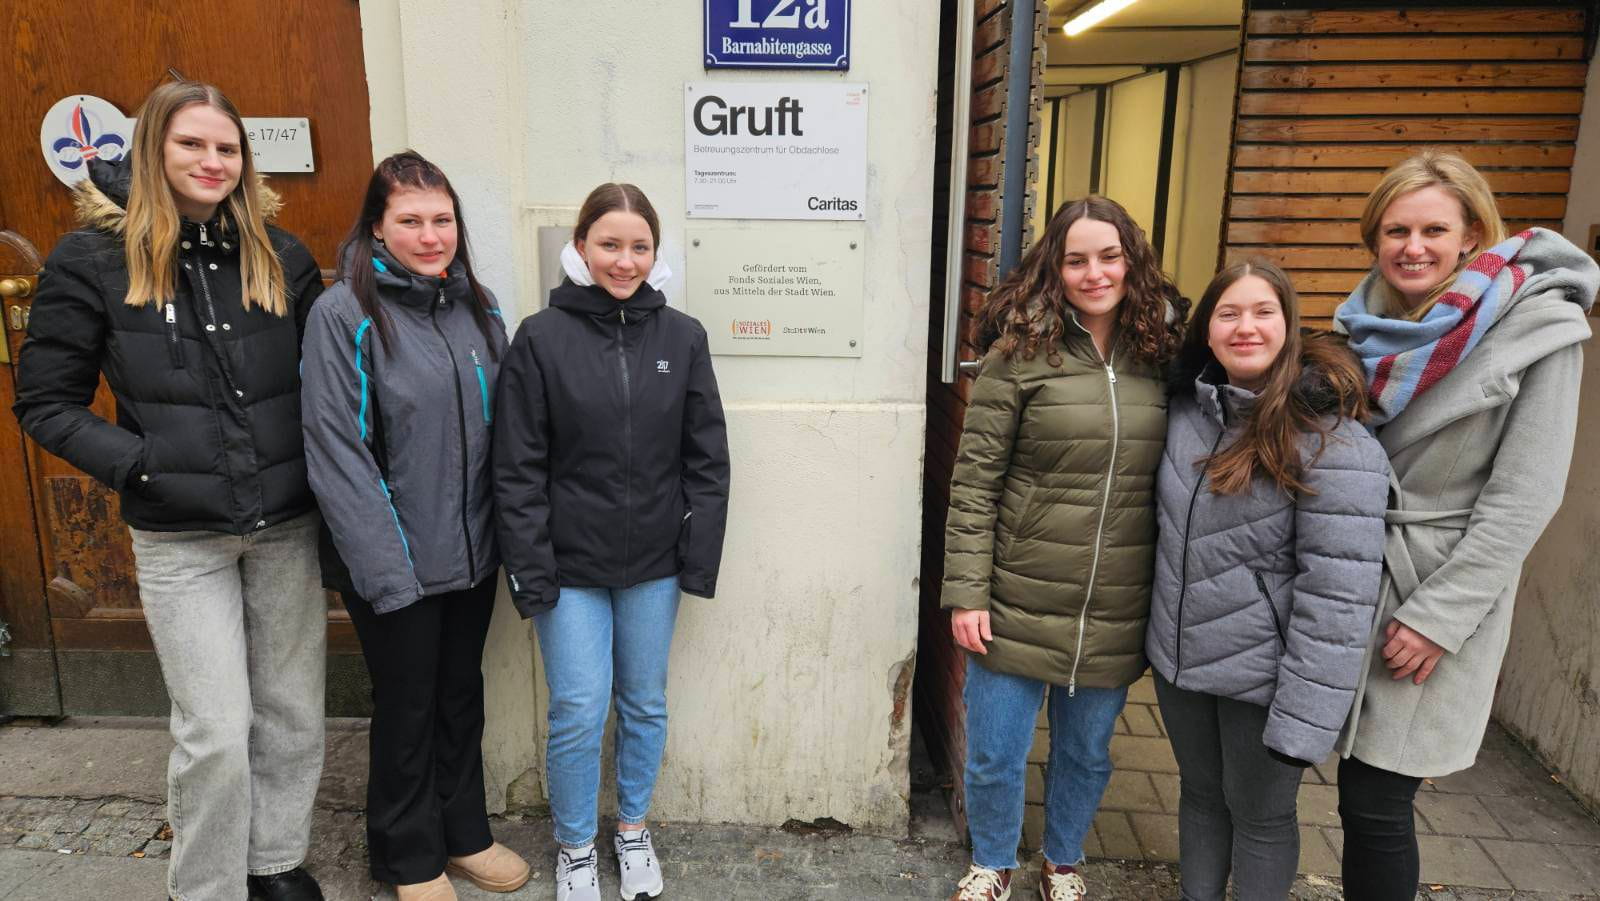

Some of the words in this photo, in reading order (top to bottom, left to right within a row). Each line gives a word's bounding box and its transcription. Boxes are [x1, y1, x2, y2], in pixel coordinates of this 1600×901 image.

[722, 36, 832, 58] Barnabitengasse
[693, 95, 804, 136] Gruft
[260, 128, 297, 142] 17/47
[693, 145, 773, 155] Betreuungszentrum
[776, 145, 787, 154] für
[789, 145, 840, 155] Obdachlose
[807, 196, 858, 211] Caritas
[742, 264, 786, 273] Gefördert
[788, 265, 807, 273] vom
[728, 275, 755, 284] Fonds
[757, 275, 794, 285] Soziales
[796, 276, 822, 286] Wien,
[732, 287, 765, 296] Mitteln
[768, 287, 782, 296] der
[784, 287, 809, 296] Stadt
[811, 288, 836, 297] Wien.
[740, 326, 767, 335] WIEN
